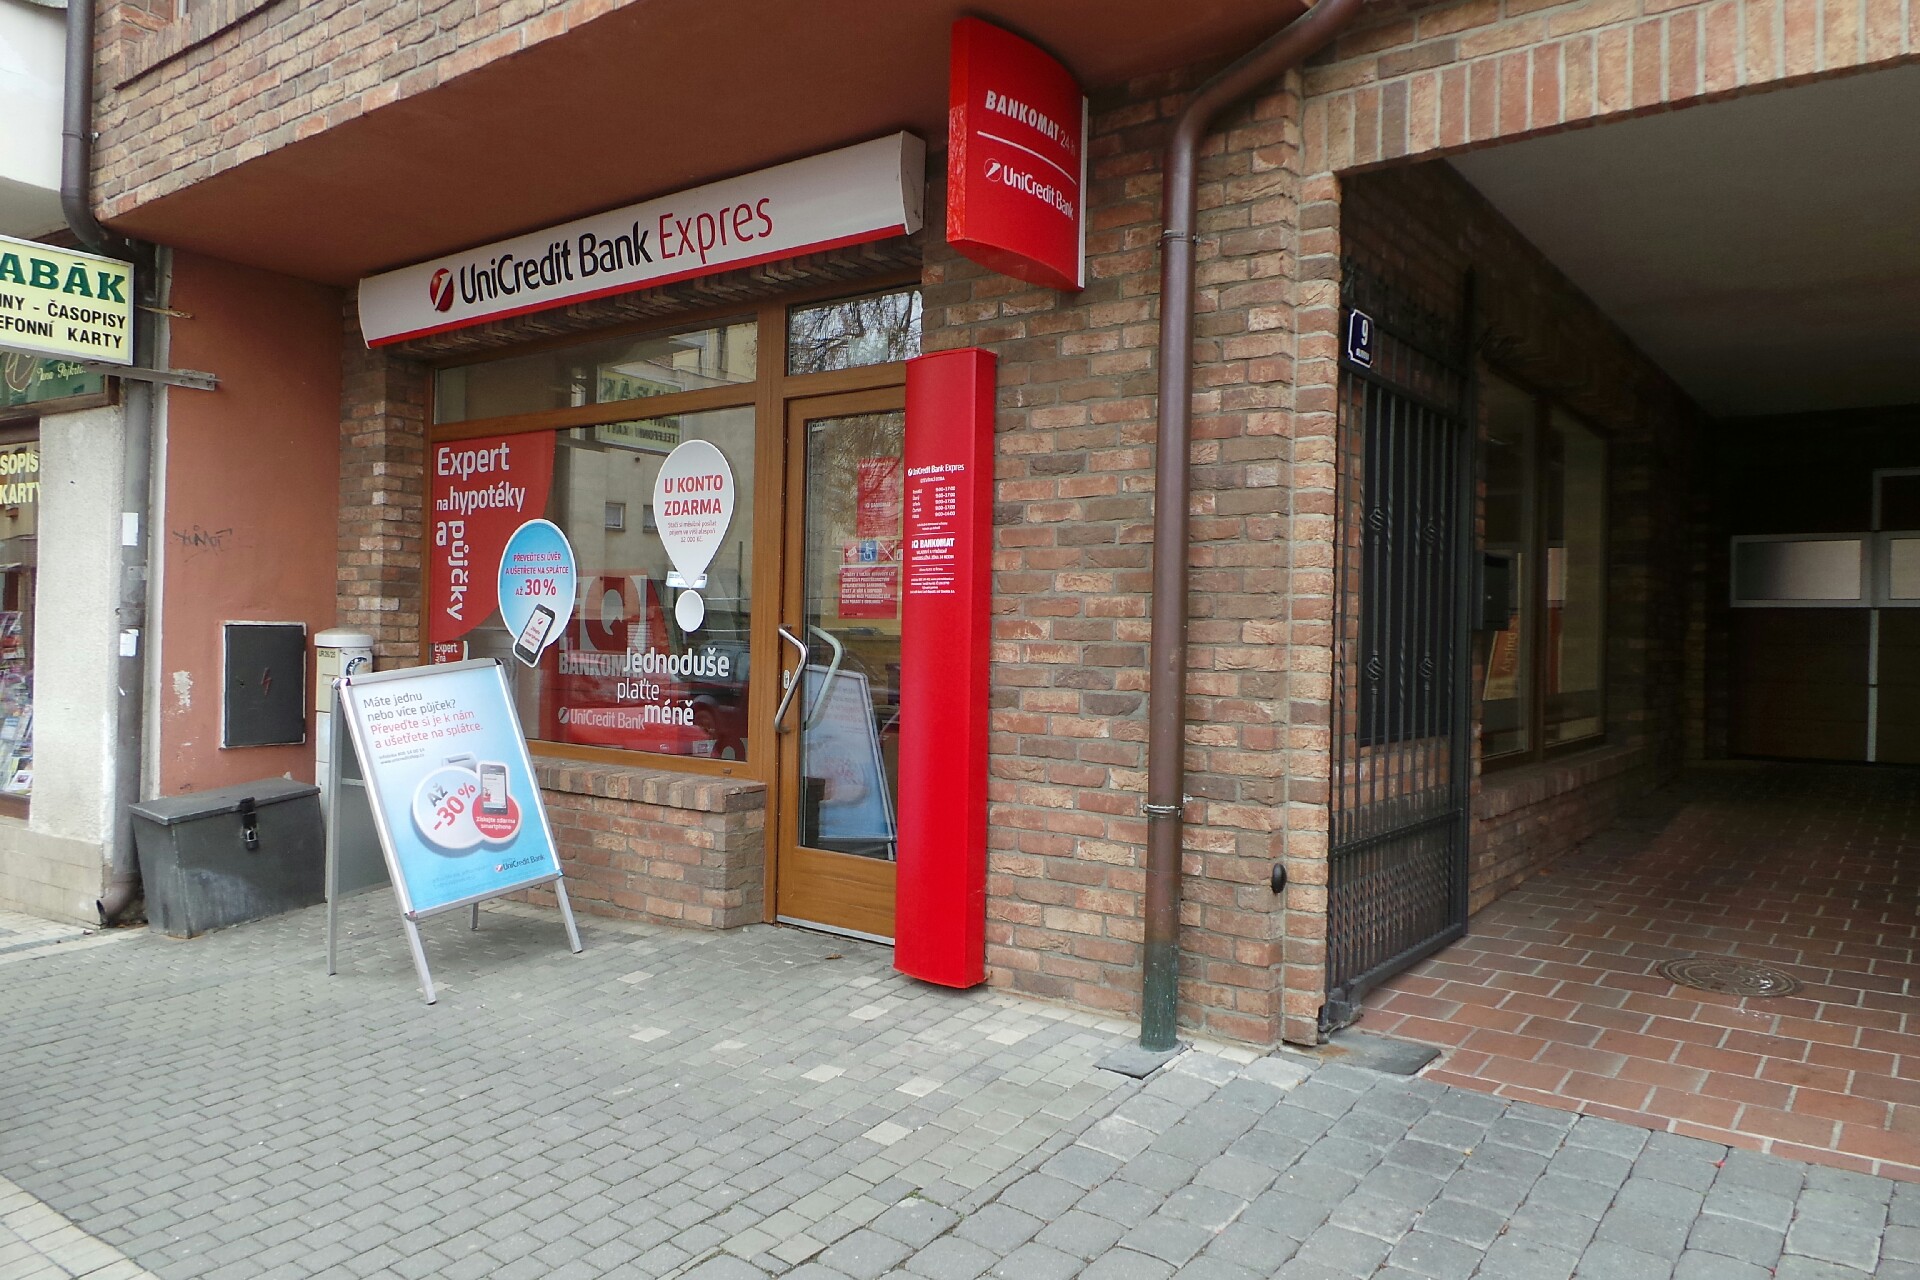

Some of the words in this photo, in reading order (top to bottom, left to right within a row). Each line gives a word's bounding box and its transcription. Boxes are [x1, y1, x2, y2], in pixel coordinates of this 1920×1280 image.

[985, 89, 1060, 141] BANKOMAT
[1060, 130, 1070, 150] 24
[1003, 164, 1055, 206] UniCredit
[1056, 190, 1074, 221] Bank
[459, 242, 573, 305] UniCredit
[578, 221, 653, 278] Bank
[659, 197, 774, 264] Expres
[47, 299, 126, 329] ČASOPISY
[67, 327, 122, 349] KARTY
[1361, 319, 1369, 346] 9
[437, 442, 510, 481] Expert
[664, 478, 674, 494] U
[677, 474, 724, 493] KONTO
[436, 498, 448, 511] na
[450, 481, 526, 515] hypotéky
[663, 498, 722, 516] ZDARMA
[505, 567, 510, 575] A
[510, 565, 537, 575] UŠETŘETE
[537, 566, 545, 574] NA
[546, 565, 569, 575] SPLÁTCE
[513, 552, 540, 562] PŘEVEĎTE
[547, 552, 561, 561] ÚVĚR
[435, 521, 447, 546] a
[446, 520, 470, 621] půjčky
[515, 585, 523, 596] AŽ
[524, 578, 541, 596] 30
[543, 578, 557, 596] %
[623, 647, 730, 677] Jednoduše
[363, 696, 391, 709] Máte
[393, 692, 423, 707] jednu
[617, 678, 660, 703] plaťte
[367, 709, 394, 722] nebo
[396, 705, 417, 718] více
[419, 699, 456, 715] půjček?
[370, 719, 419, 735] Převeďte
[421, 717, 431, 727] si
[432, 715, 442, 727] je
[444, 713, 451, 722] k
[452, 709, 475, 721] nám
[570, 708, 616, 728] UniCredit
[617, 713, 645, 730] Bank
[644, 698, 694, 726] méně
[375, 739, 382, 749] a
[384, 731, 429, 747] ušetřete
[430, 730, 444, 739] na
[446, 722, 484, 737] splátce.
[502, 858, 530, 871] UniCredit
